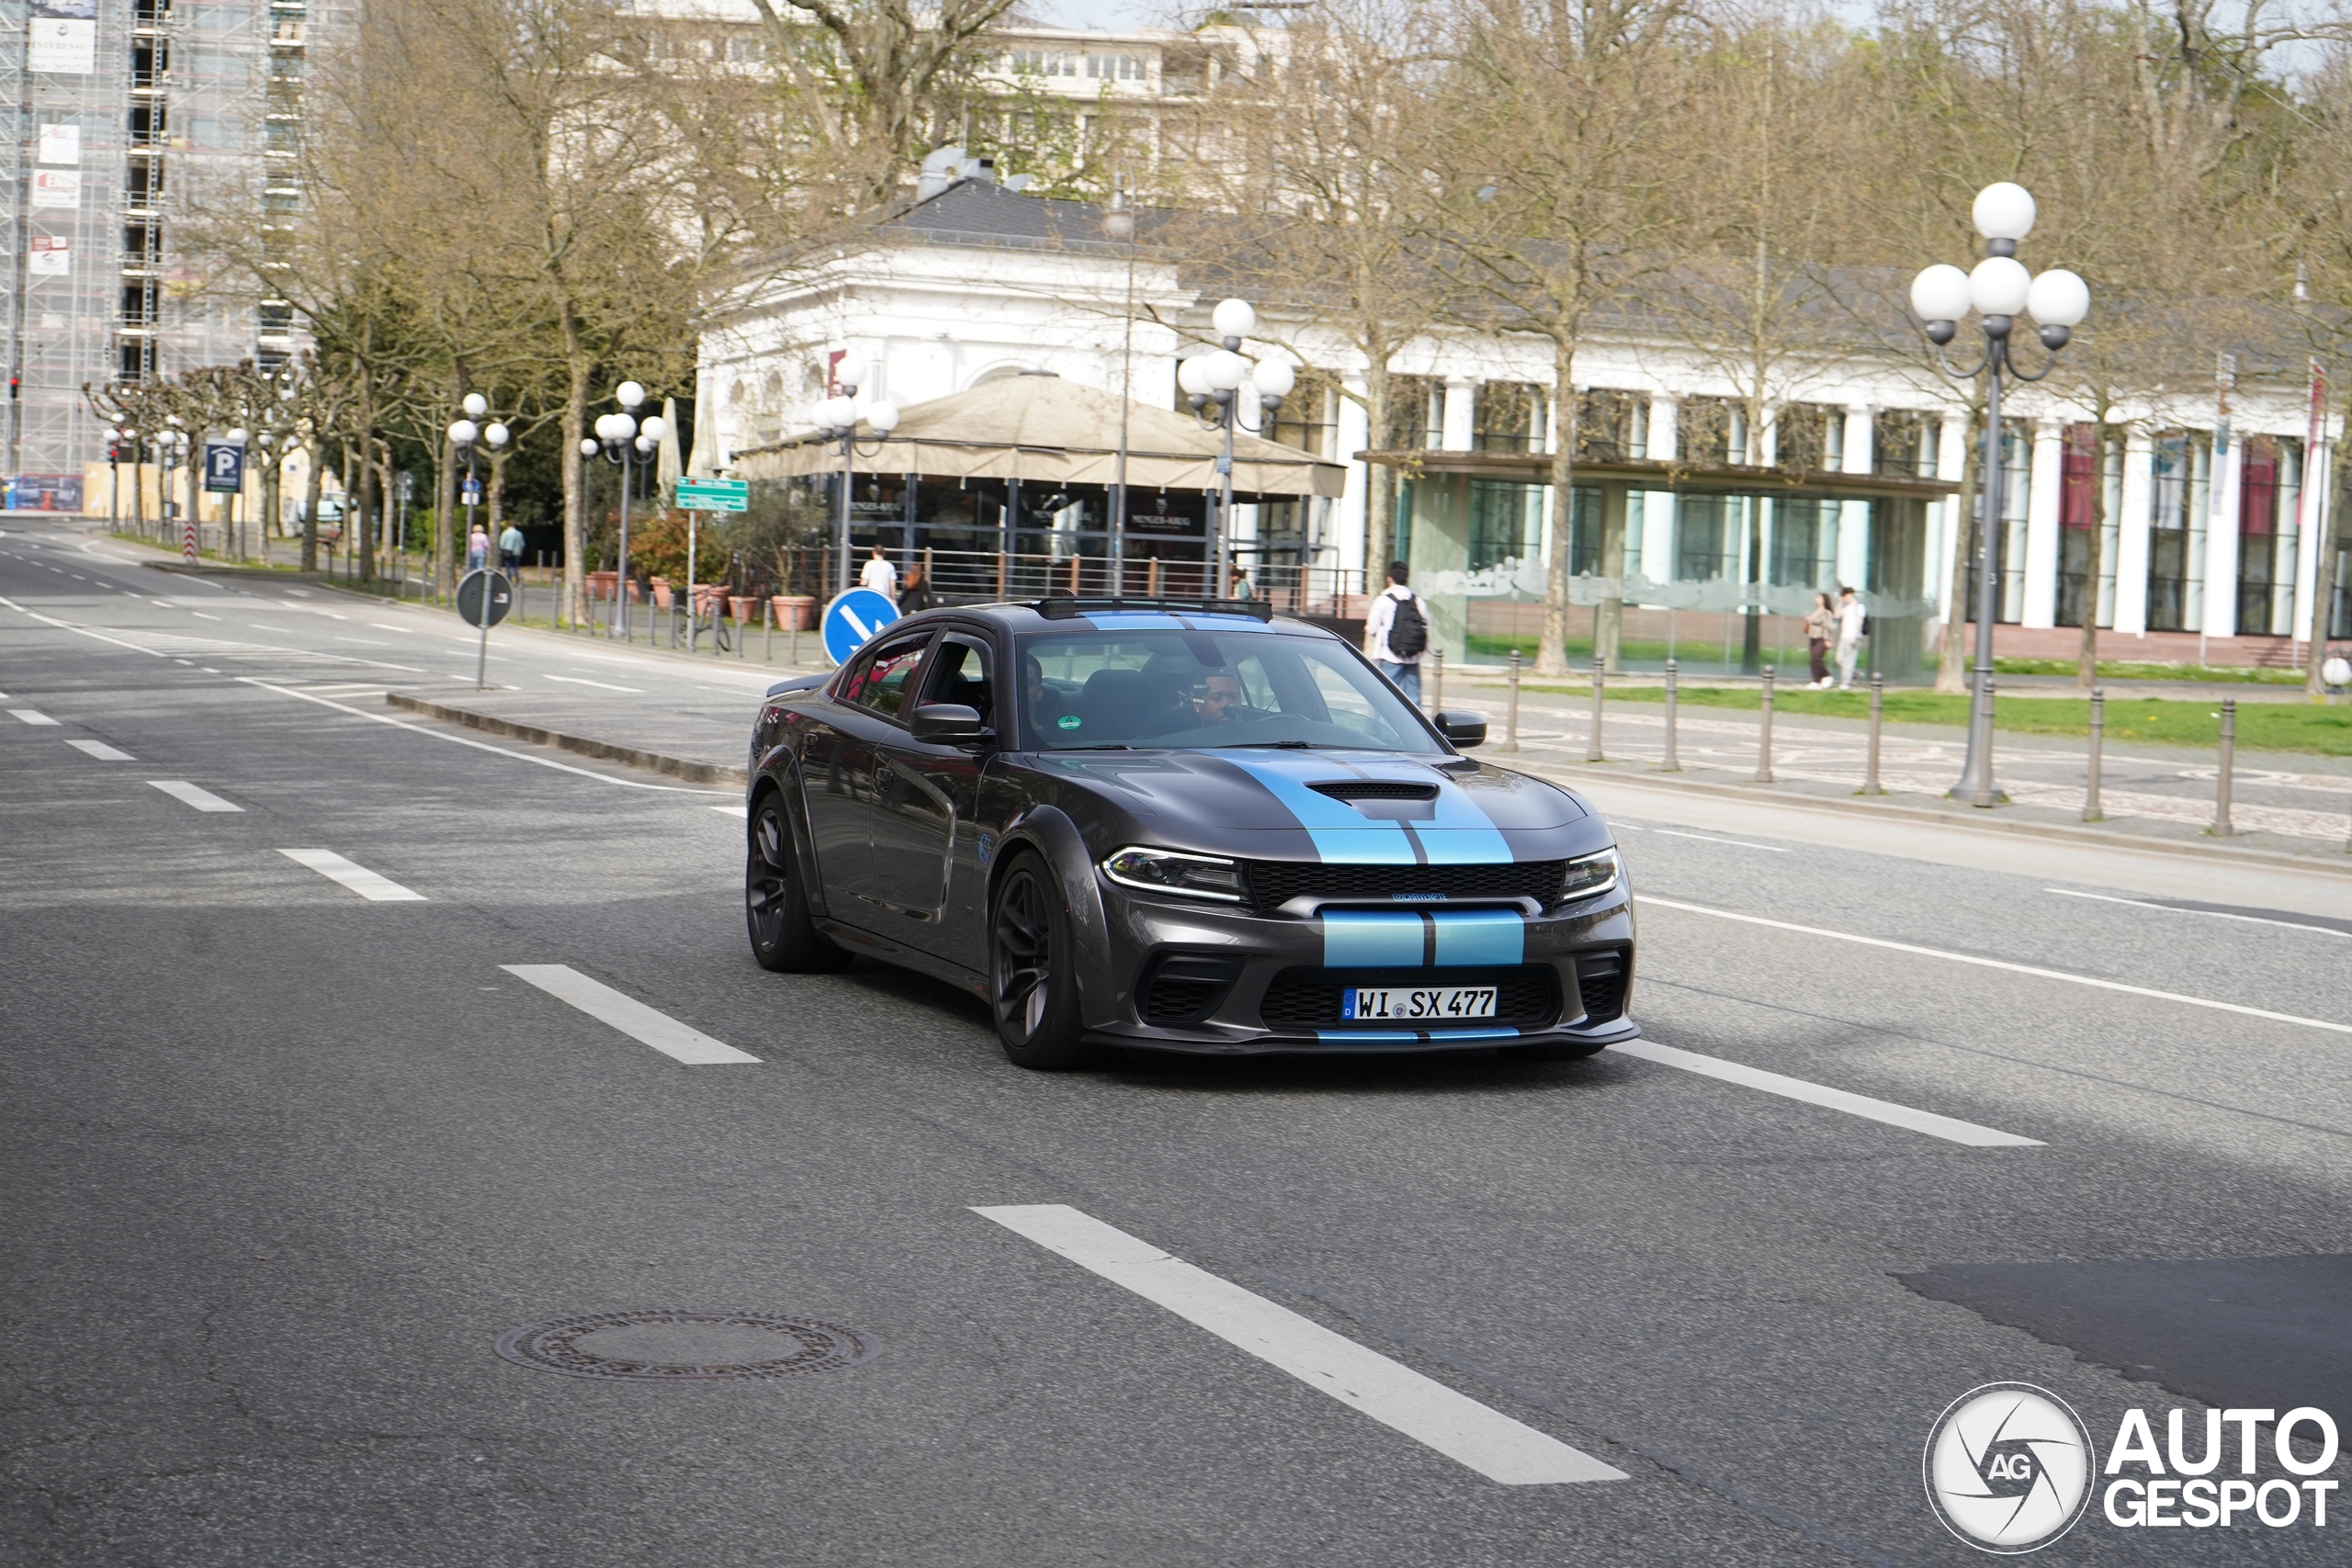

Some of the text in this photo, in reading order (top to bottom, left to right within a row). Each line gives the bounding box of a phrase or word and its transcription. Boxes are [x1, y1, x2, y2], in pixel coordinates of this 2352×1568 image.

[215, 453, 235, 476] P
[1344, 990, 1495, 1017] D WI SX 477
